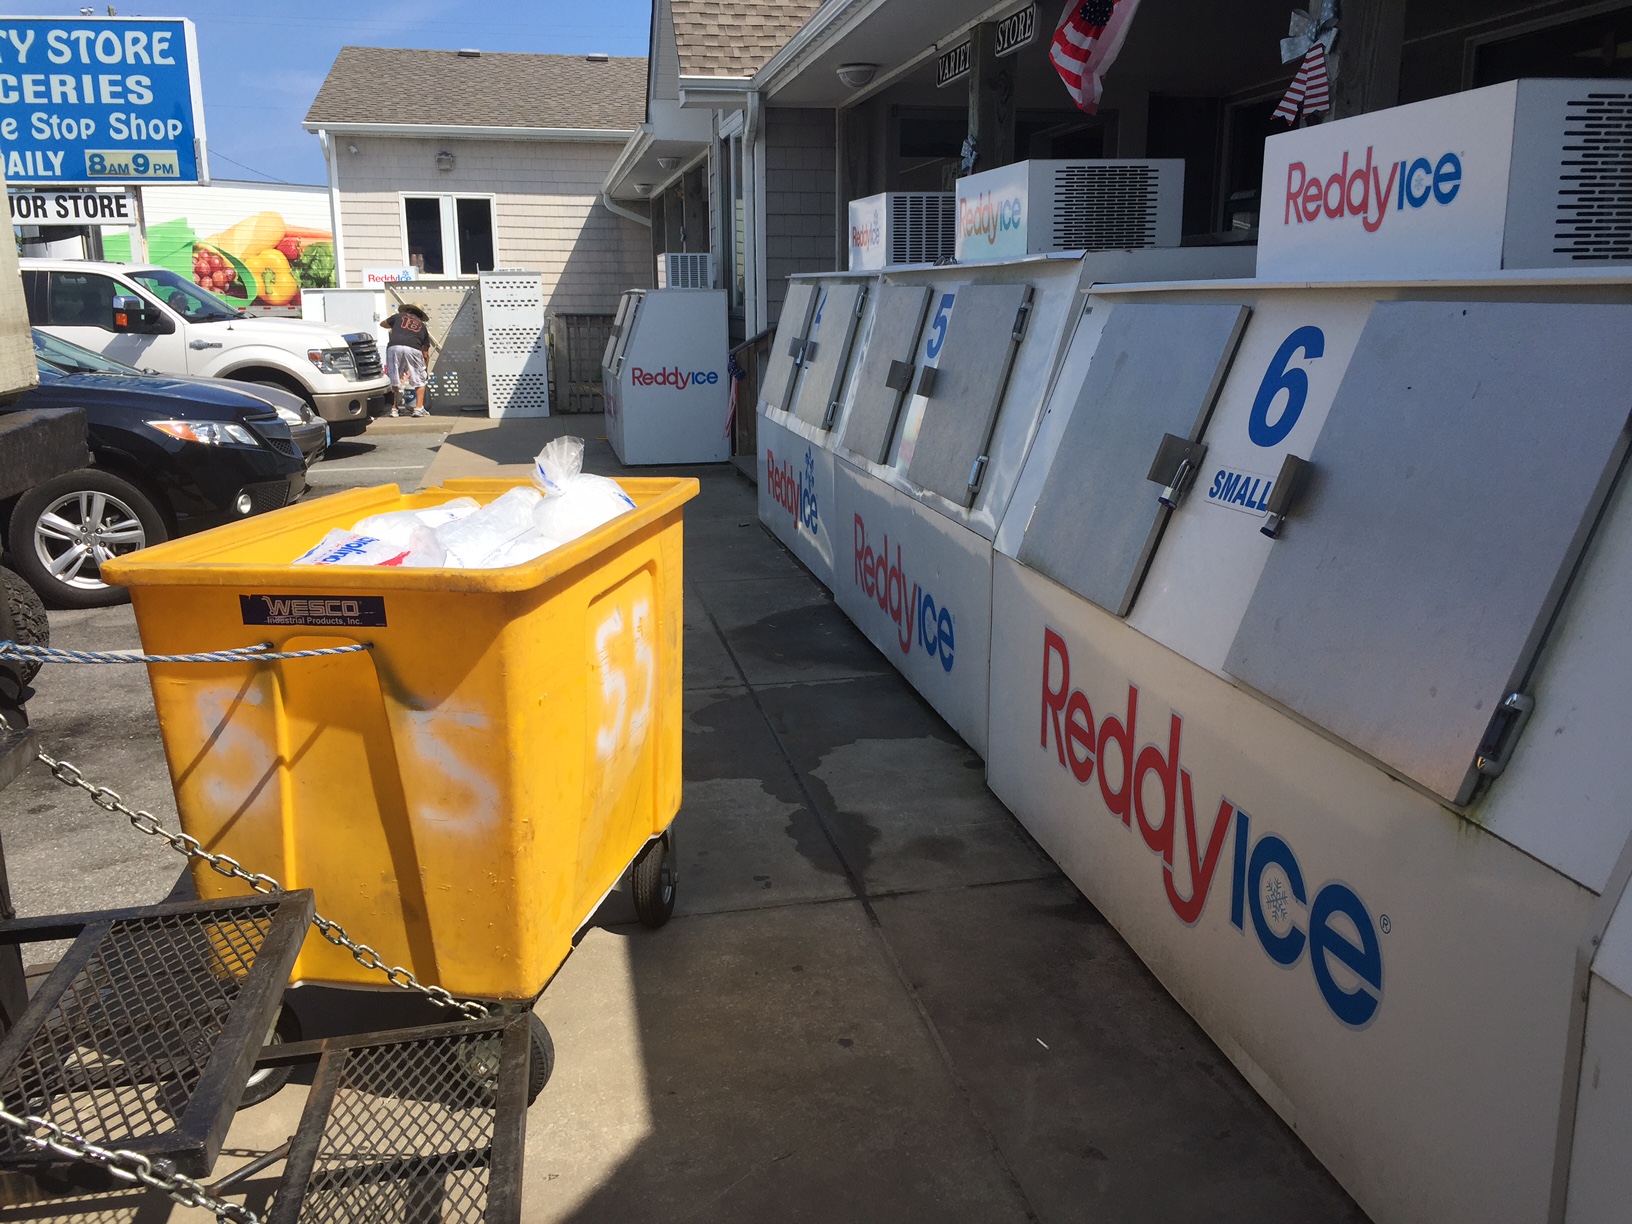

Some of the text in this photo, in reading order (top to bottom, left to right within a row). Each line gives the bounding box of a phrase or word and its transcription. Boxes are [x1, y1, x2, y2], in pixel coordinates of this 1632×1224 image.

[47, 29, 175, 65] STORE
[997, 7, 1033, 52] STORE
[939, 43, 970, 81] VARIET
[31, 112, 96, 140] Stop
[109, 112, 182, 140] Shop
[1, 151, 65, 176] AILY
[55, 195, 128, 218] STORE
[926, 294, 955, 358] 5
[1248, 325, 1325, 447] 6
[1208, 470, 1272, 512] SMALL
[261, 595, 360, 617] WESCO
[266, 616, 305, 624] Industrial
[307, 617, 346, 626] Products,
